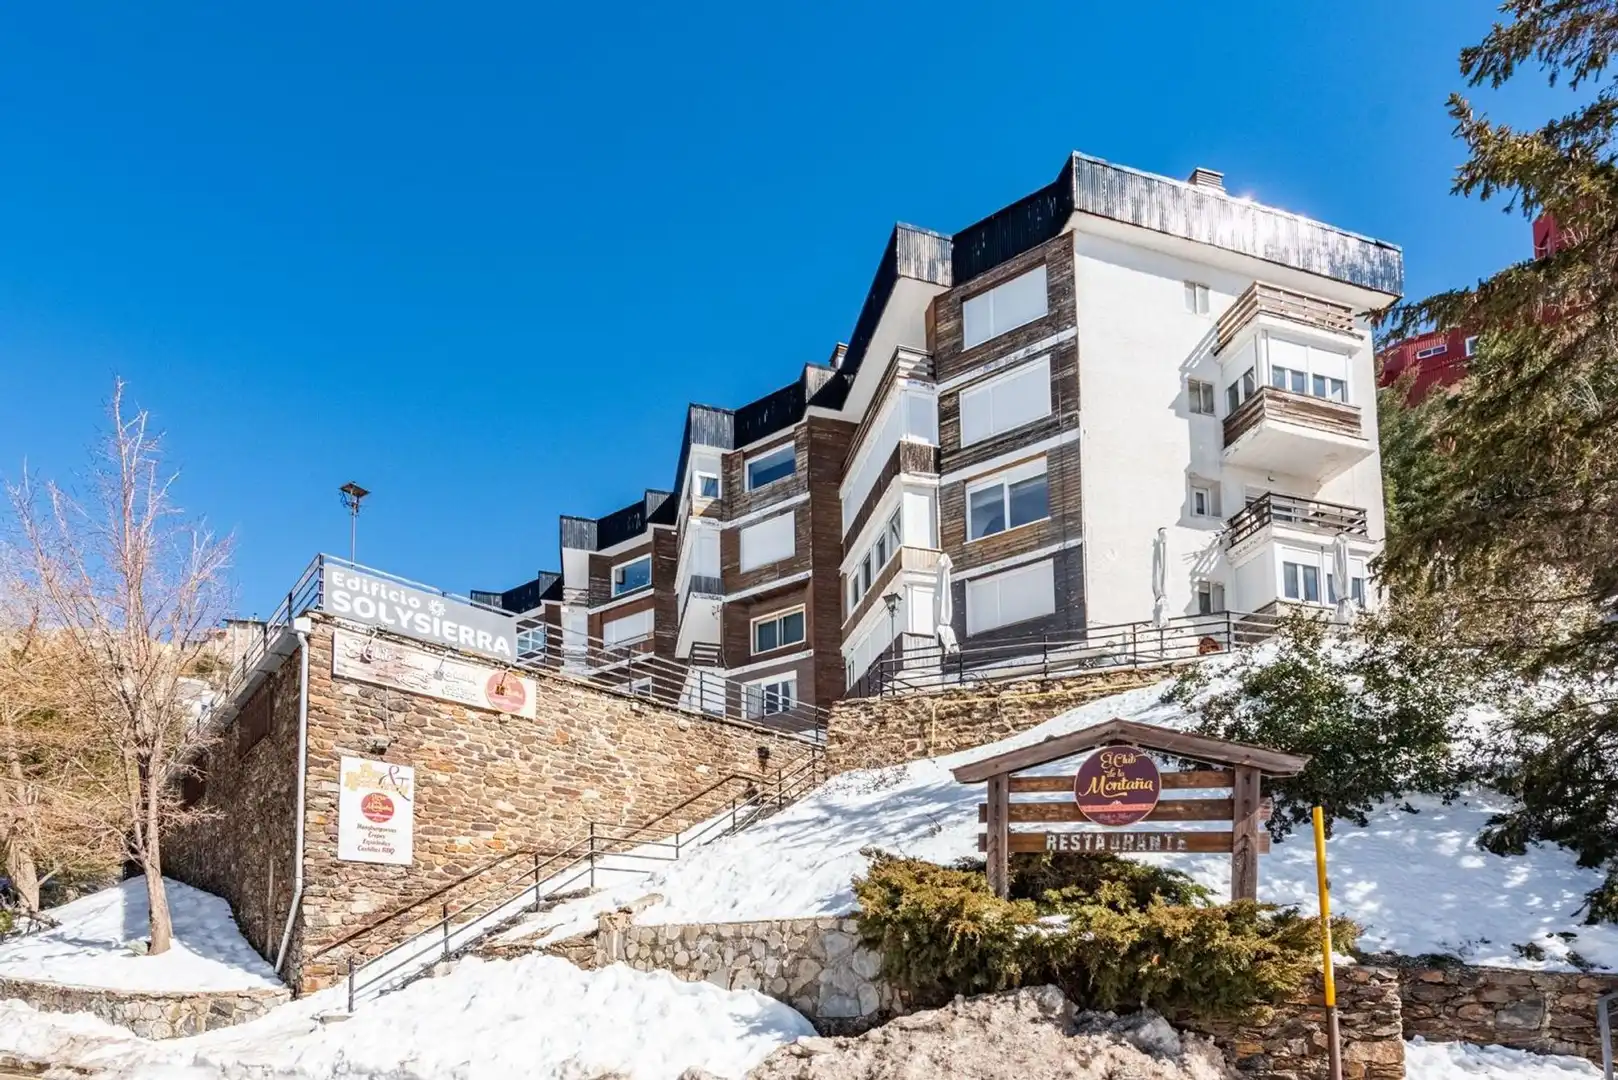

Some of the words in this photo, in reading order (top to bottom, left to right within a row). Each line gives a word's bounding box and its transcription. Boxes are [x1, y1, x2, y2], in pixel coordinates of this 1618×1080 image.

[331, 571, 421, 608] Edificio
[331, 589, 511, 656] SOLYSIERRA
[1100, 751, 1114, 769] El
[1113, 753, 1139, 768] Club
[1104, 767, 1116, 777] de
[1117, 768, 1125, 778] la
[1078, 775, 1154, 798] Montaña
